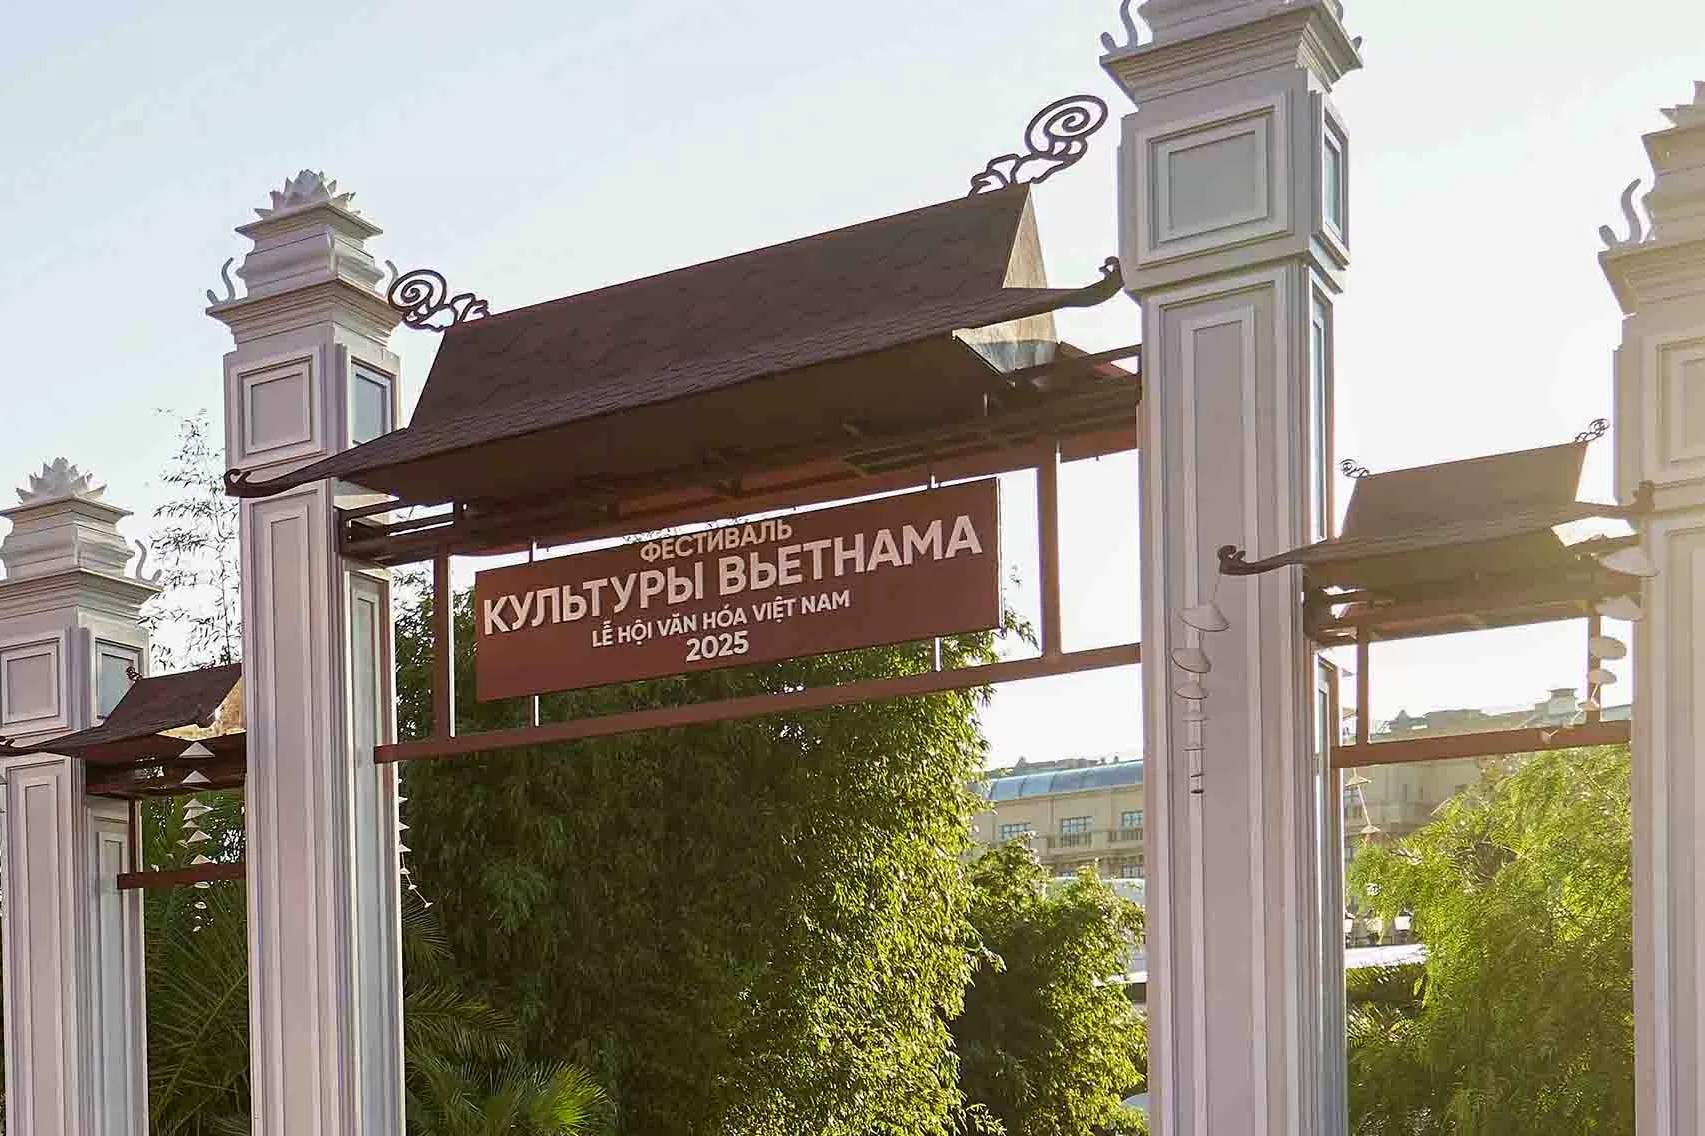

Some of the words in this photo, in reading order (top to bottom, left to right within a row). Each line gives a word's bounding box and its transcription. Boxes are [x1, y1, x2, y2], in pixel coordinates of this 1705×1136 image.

[640, 519, 793, 562] ФЕСТИВАЛЬ
[484, 561, 704, 635] КУЛЬТУРЫ
[719, 514, 982, 596] ВЬЕТНАМА
[592, 620, 614, 647] LỄ
[618, 619, 653, 646] HỘI
[657, 611, 697, 637] VĂN
[702, 603, 748, 630] HÓA
[752, 595, 797, 624] VIỆT
[800, 590, 851, 615] NAM
[686, 631, 750, 662] 2025
